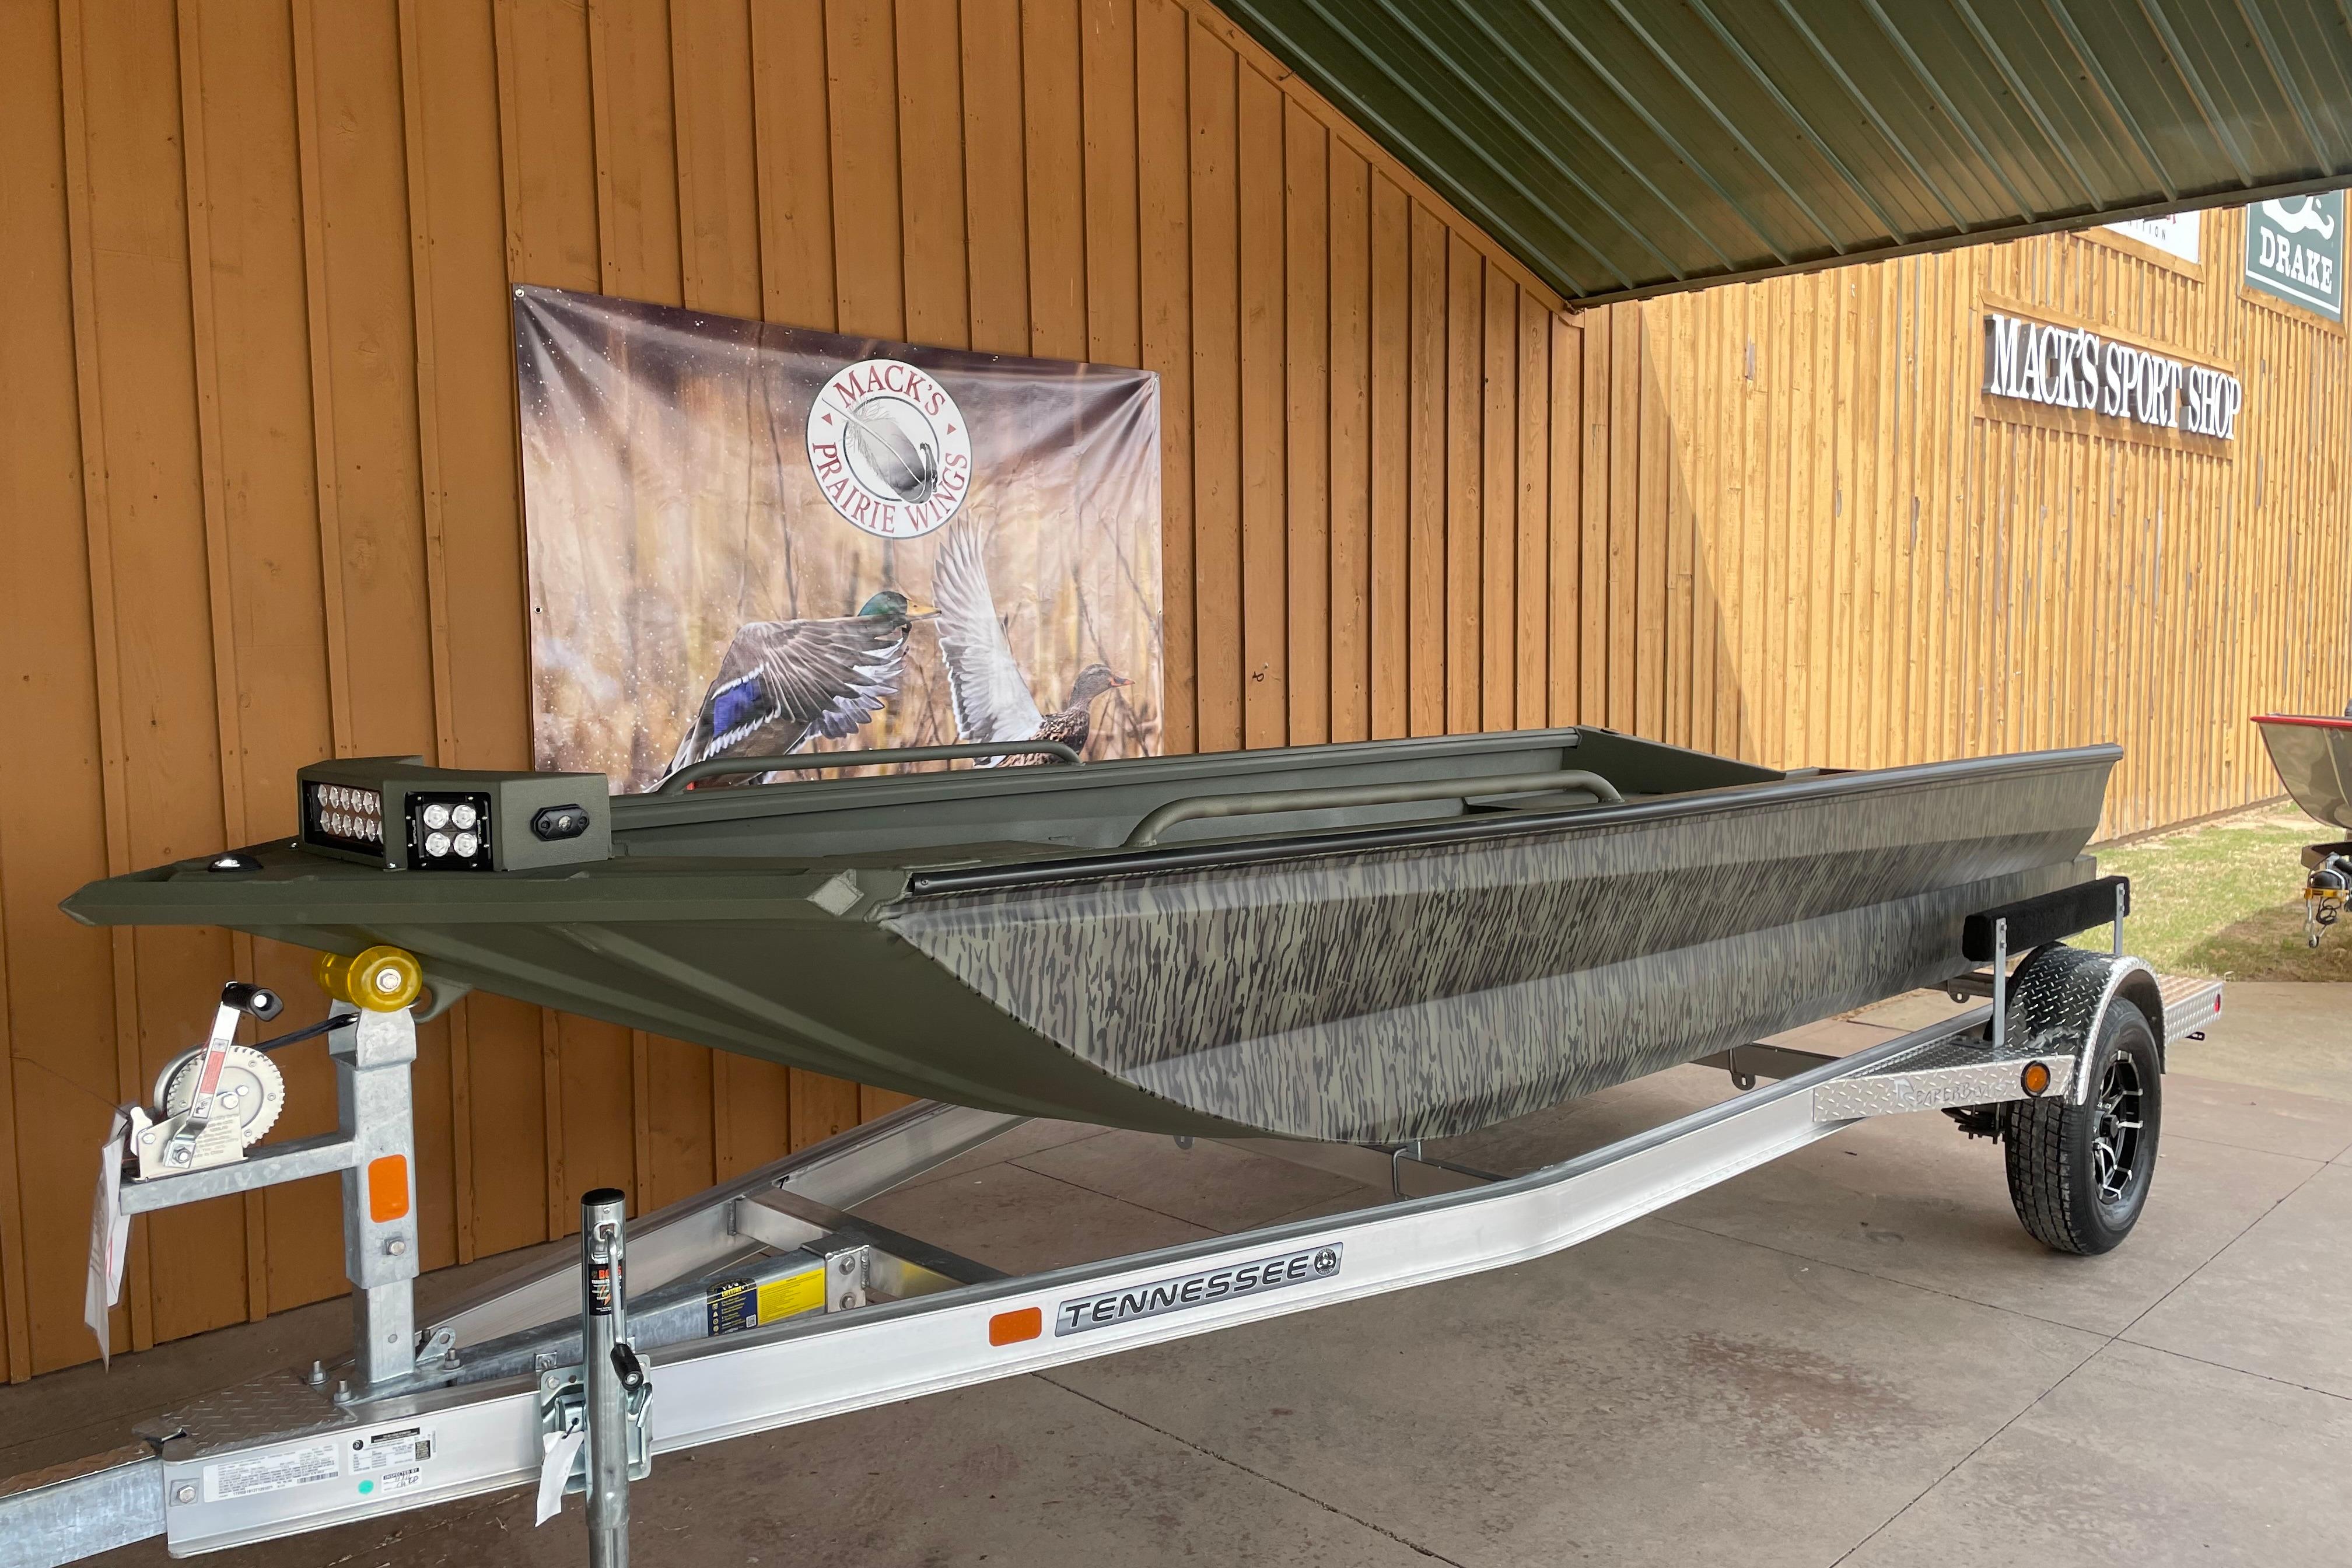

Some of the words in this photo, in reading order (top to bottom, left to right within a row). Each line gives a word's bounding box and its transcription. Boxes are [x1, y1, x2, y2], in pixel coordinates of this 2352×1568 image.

[2259, 226, 2333, 295] DRAKE
[833, 365, 946, 416] MACK'S
[1990, 313, 2100, 410] MACK'S
[2104, 341, 2182, 428] SPORT
[2188, 364, 2242, 440] SHOP
[812, 442, 895, 534] PRAIRIE
[904, 452, 968, 532] WINGS
[1065, 1255, 1309, 1328] TENNESSEE
